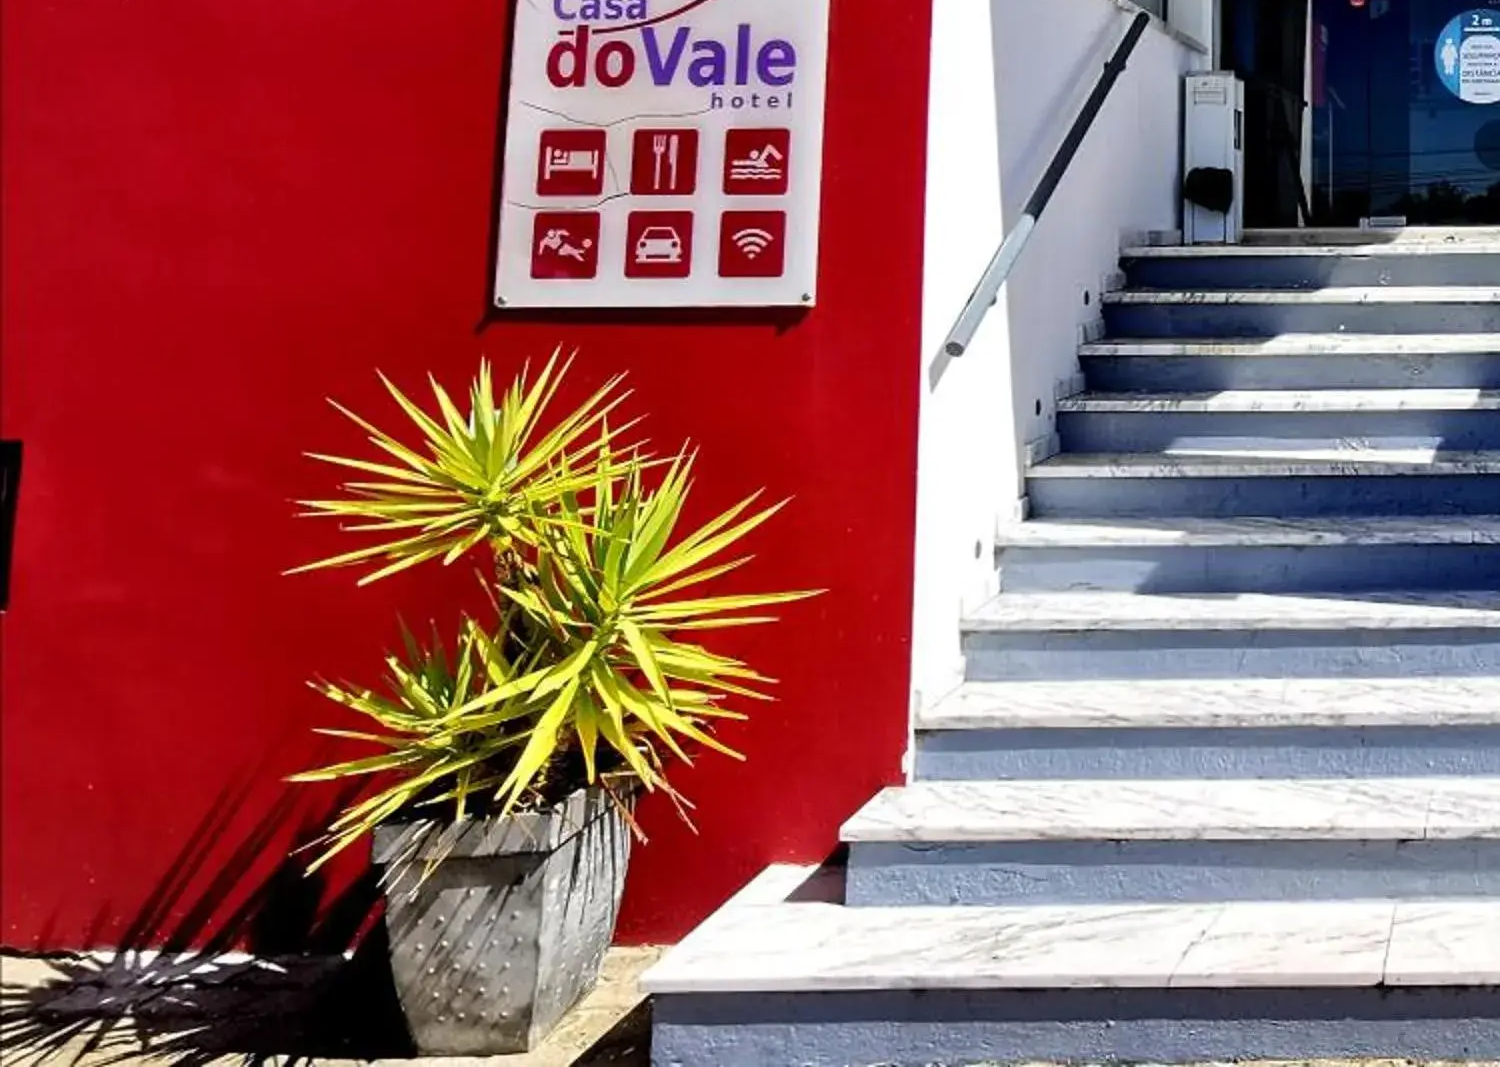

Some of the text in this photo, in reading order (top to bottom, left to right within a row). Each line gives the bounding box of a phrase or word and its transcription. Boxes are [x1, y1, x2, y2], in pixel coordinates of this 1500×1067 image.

[1471, 14, 1493, 26] 2 m
[709, 93, 793, 109] hotel
